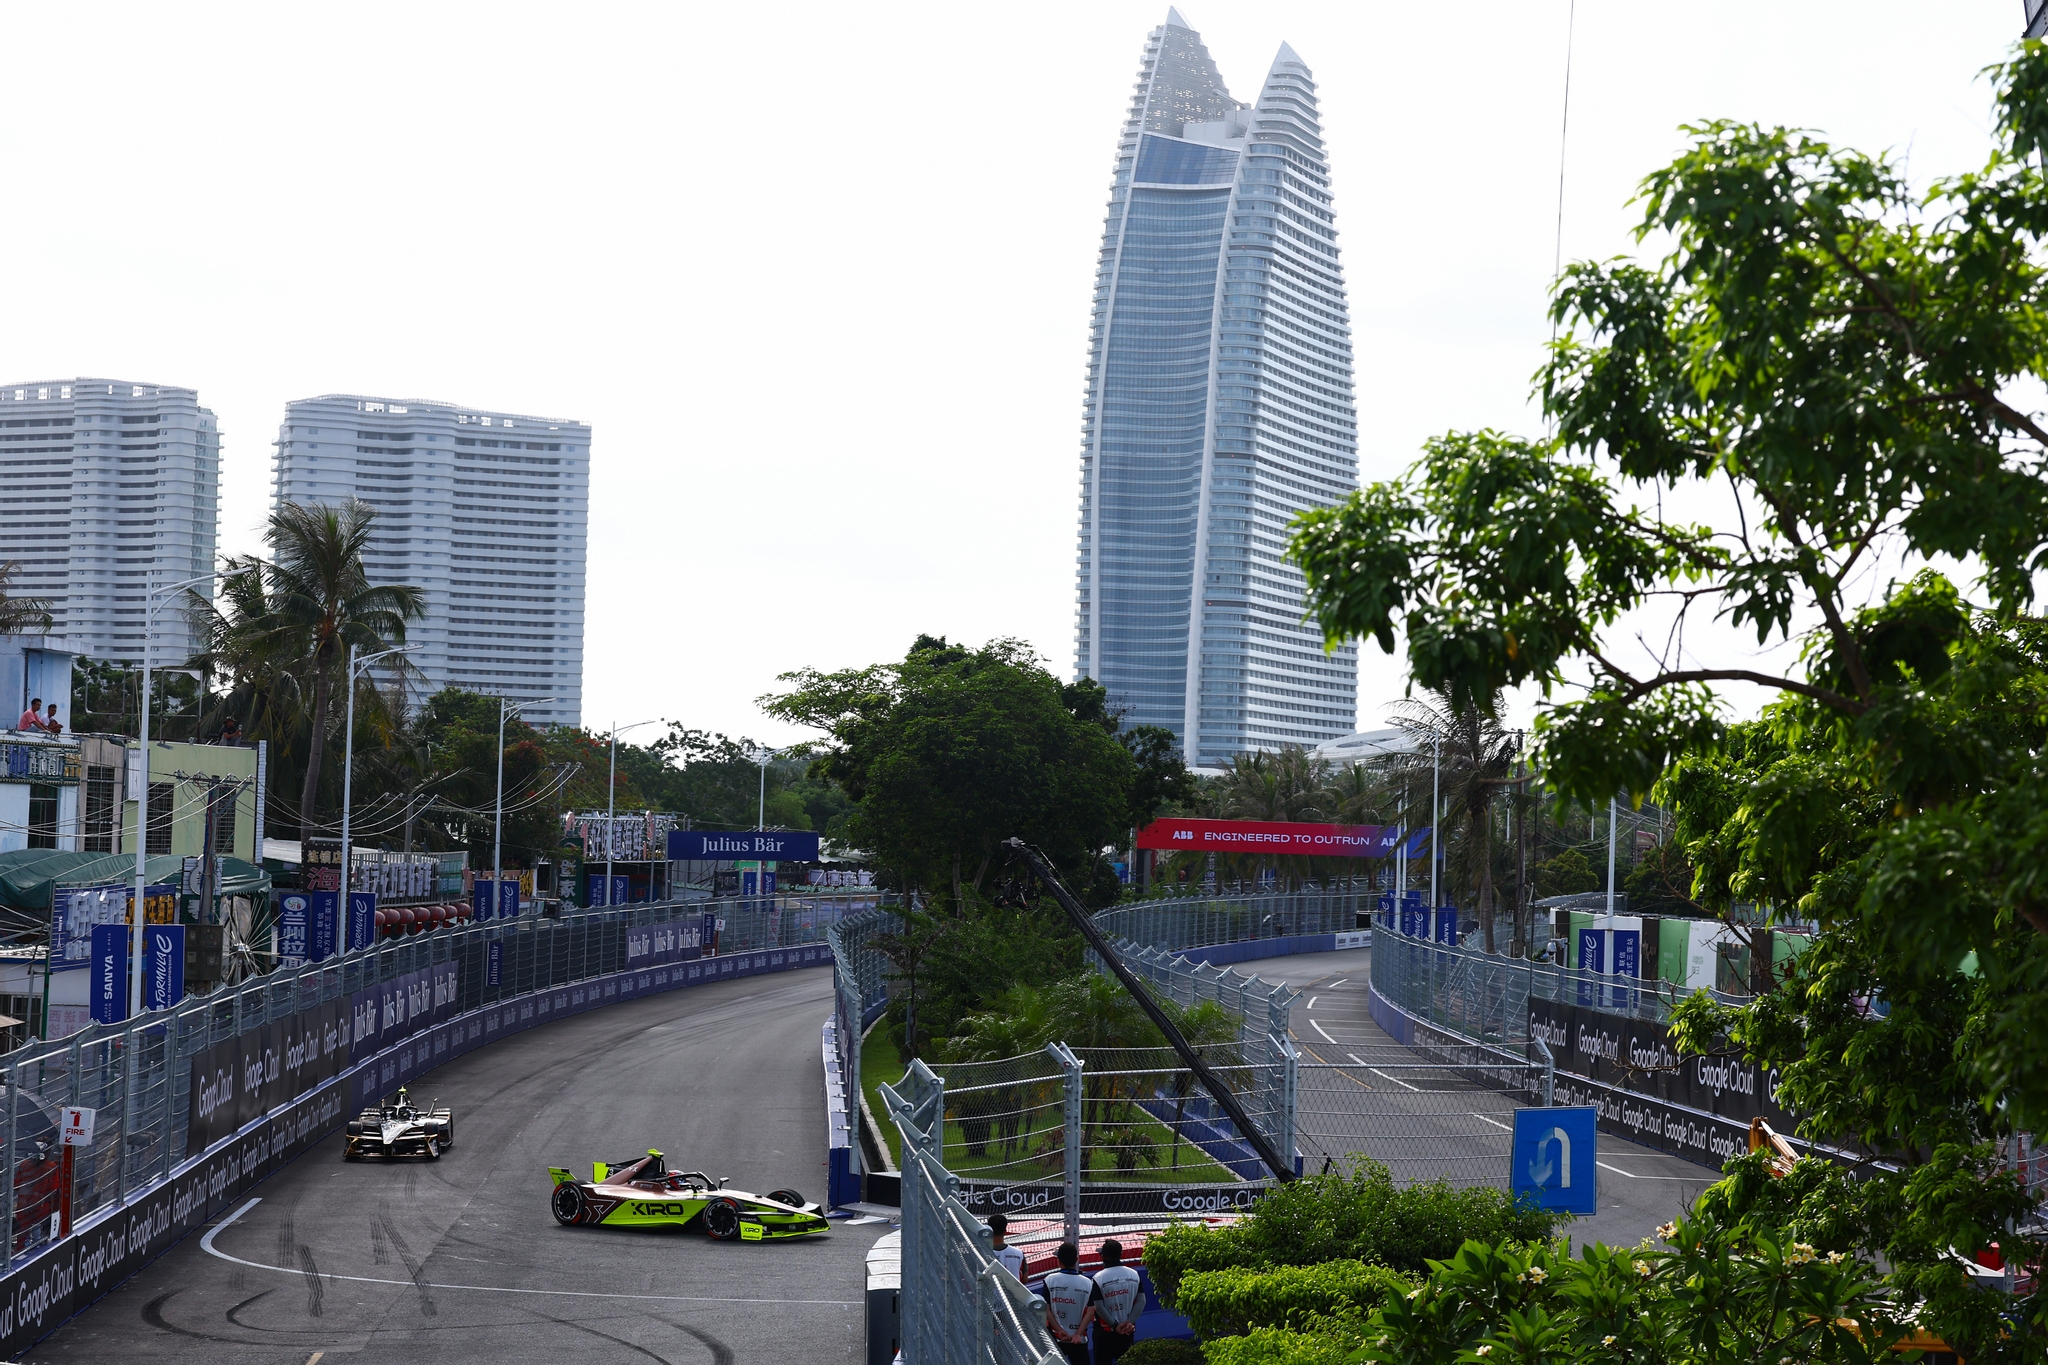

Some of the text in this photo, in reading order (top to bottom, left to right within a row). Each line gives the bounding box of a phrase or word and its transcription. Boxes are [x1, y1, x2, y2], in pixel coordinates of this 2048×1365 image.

[702, 837, 784, 854] Julius Bär
[1173, 831, 1194, 840] ABB
[1204, 832, 1290, 843] ENGINEERED
[1294, 835, 1311, 844] TO
[1314, 836, 1370, 846] OUTRUN
[307, 867, 341, 890] 海
[282, 912, 306, 967] 兰州拉面
[354, 912, 363, 950] FORMULA
[104, 955, 114, 1000] SANYA
[155, 952, 167, 1004] FORMULA
[490, 960, 498, 986] Julius
[1550, 1020, 1567, 1047] Cloud
[1579, 1024, 1619, 1063] Google Cloud
[1630, 1037, 1658, 1078] Google
[1553, 1079, 1570, 1105] Google
[1570, 1086, 1585, 1106] Cloud
[1698, 1056, 1728, 1097] Google
[1729, 1061, 1754, 1095] Cloud
[1605, 1096, 1620, 1121] Cloud
[1622, 1100, 1662, 1135] Google Cloud
[66, 1127, 85, 1136] FIRE
[272, 1116, 296, 1159] Google Cloud
[1664, 1113, 1706, 1149] Google Cloud
[1709, 1126, 1734, 1162] Google
[242, 1132, 269, 1178] Google Cloud
[209, 1150, 240, 1201] Google Cloud
[173, 1171, 207, 1226] Google Cloud
[631, 1203, 684, 1215] KIRO
[959, 1185, 1049, 1209] gle Cloud
[1163, 1189, 1231, 1213] Google
[129, 1195, 171, 1255] Google Cloud
[79, 1224, 125, 1288] Google Cloud
[18, 1270, 49, 1327] Google
[51, 1254, 74, 1304] Cloud
[1052, 1297, 1076, 1305] MEDICAL
[1105, 1288, 1129, 1298] MEDICAL
